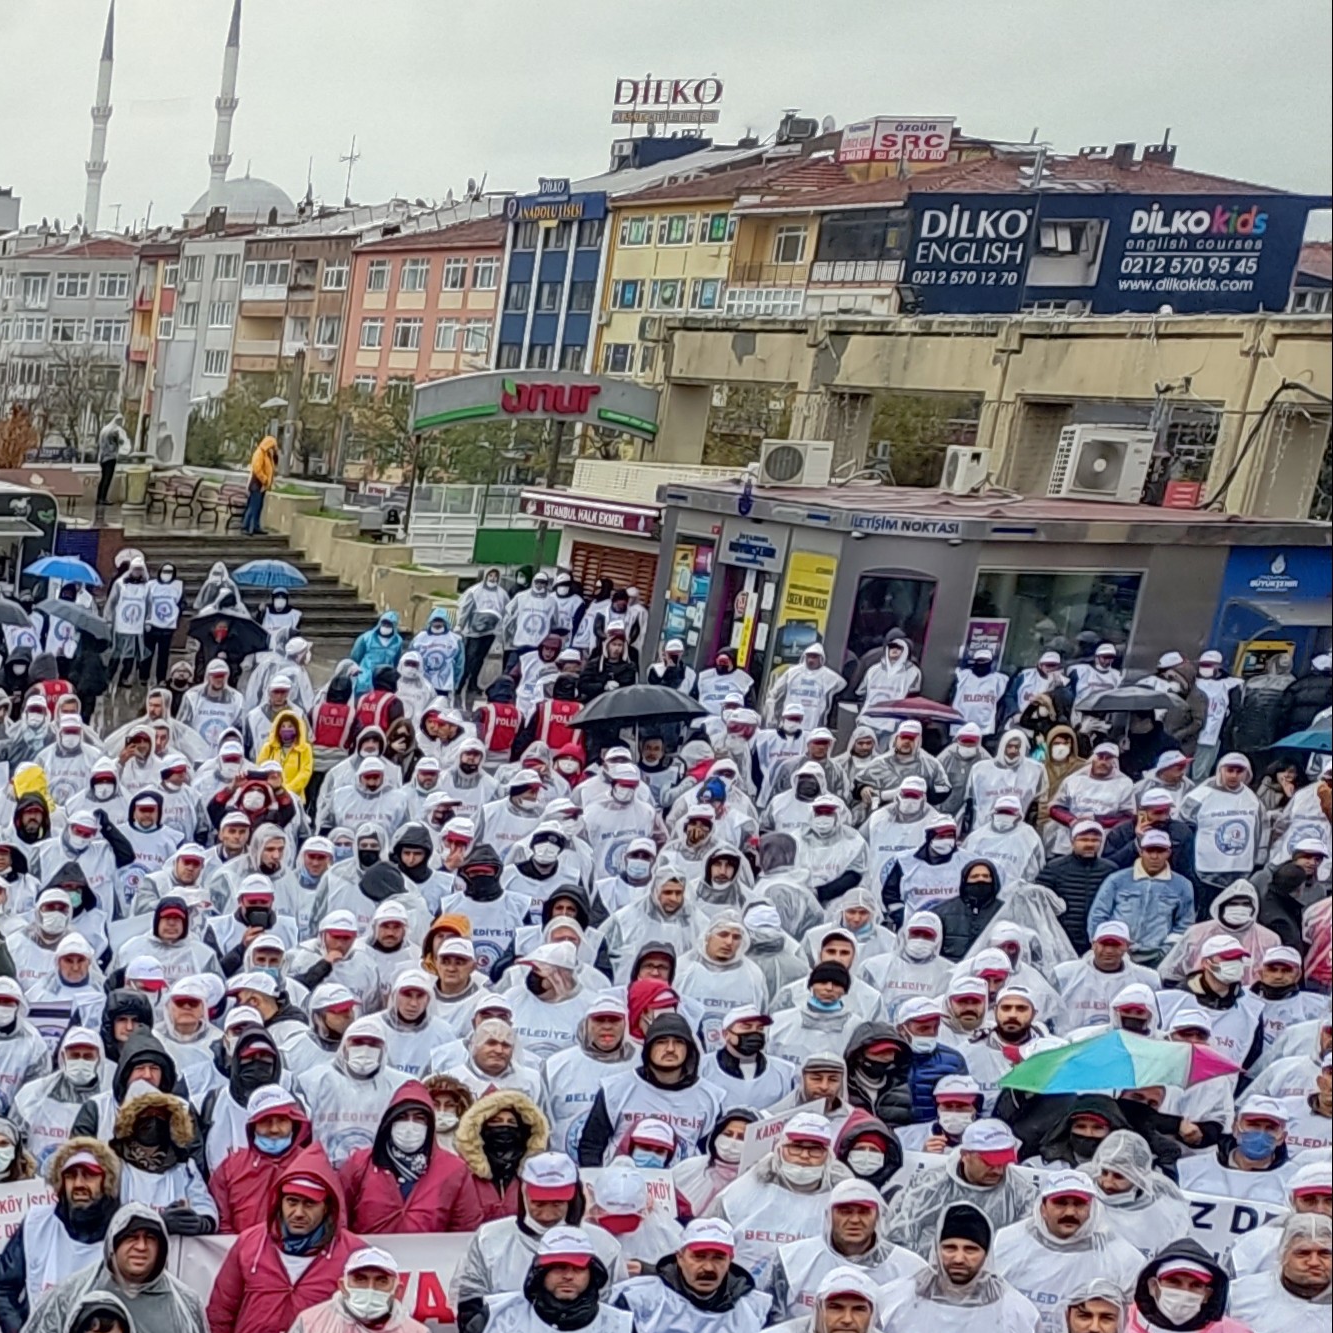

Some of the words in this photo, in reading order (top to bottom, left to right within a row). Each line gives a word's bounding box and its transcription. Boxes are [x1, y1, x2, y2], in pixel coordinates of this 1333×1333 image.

[614, 72, 723, 105] DİLKO
[880, 134, 945, 149] SRC
[920, 203, 1028, 239] DİLKO
[1130, 203, 1269, 234] DİLKOkids
[916, 241, 1024, 265] ENGLISH
[1126, 237, 1188, 251] english
[1196, 239, 1263, 249] courses
[1121, 257, 1165, 274] 0212
[1170, 257, 1203, 274] 570
[1208, 257, 1230, 274] 95
[1235, 257, 1257, 274] 45
[912, 270, 946, 284] 0212
[950, 270, 976, 285] 570
[980, 271, 997, 285] 12
[1000, 271, 1018, 285] 70
[1118, 277, 1254, 291] www.dilkokids.com
[543, 503, 576, 520] İSTANBUL
[578, 510, 597, 524] HALK
[599, 511, 624, 528] EKMEK
[851, 514, 898, 531] İLETİŞİM
[900, 521, 959, 533] NOKTASI
